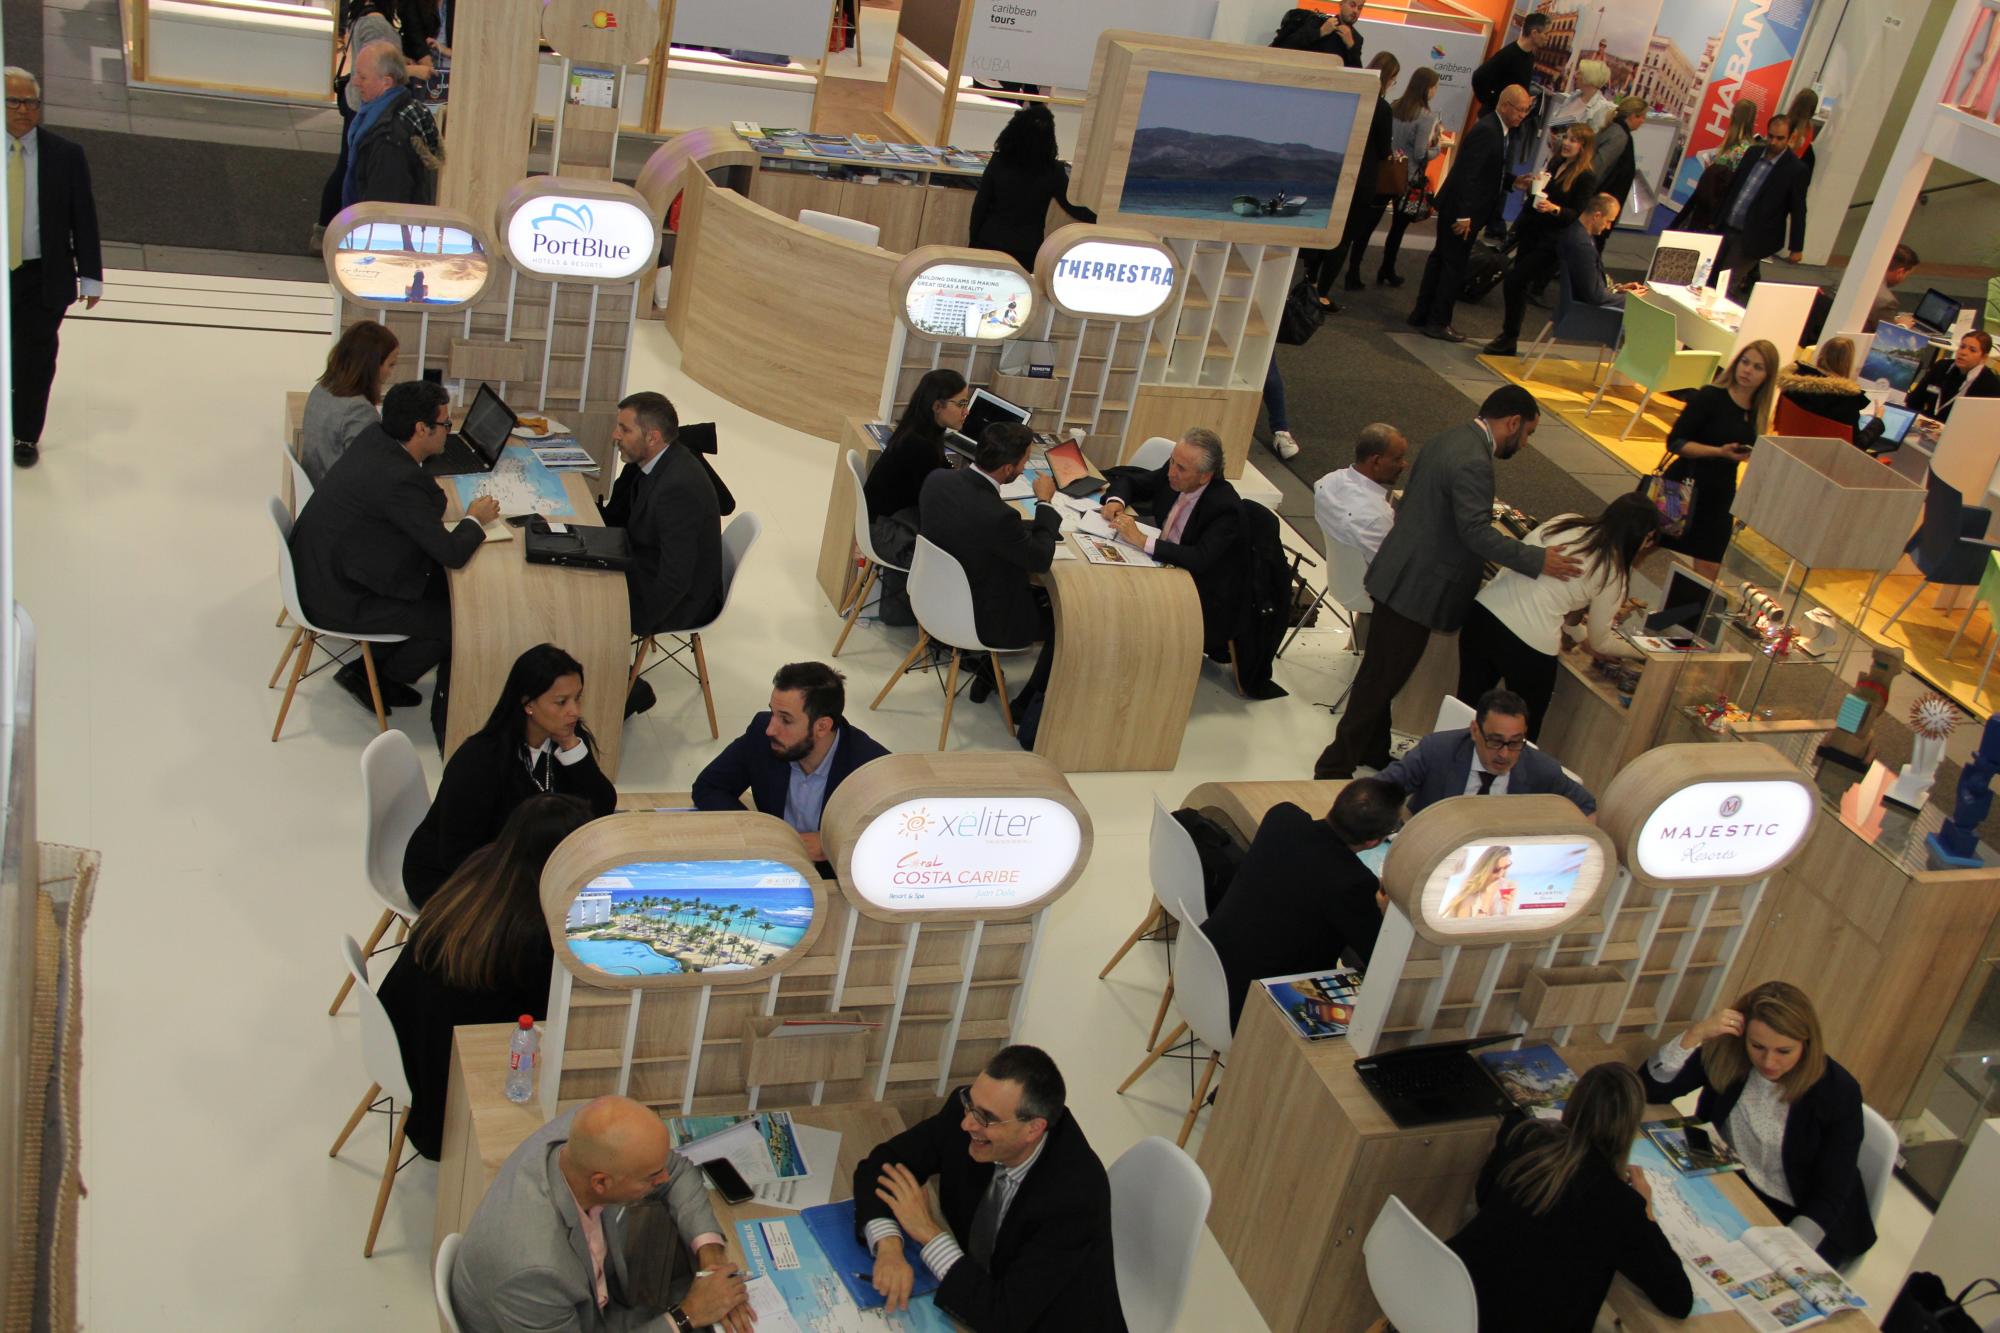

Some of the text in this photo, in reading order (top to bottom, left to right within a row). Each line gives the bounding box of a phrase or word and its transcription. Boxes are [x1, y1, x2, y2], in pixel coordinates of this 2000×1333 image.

[992, 4, 1037, 17] caribbean
[990, 14, 1016, 25] tours
[971, 56, 1011, 72] KUBA
[1434, 62, 1472, 73] caribbean
[533, 233, 630, 260] PortBlue
[532, 257, 560, 265] HOTELS
[571, 261, 603, 269] RESORTS
[1059, 259, 1173, 286] THERRESTRA
[917, 280, 936, 288] GREAT
[1660, 823, 1780, 840] MAJESTIC
[893, 870, 1020, 885] COSTA CARIBE
